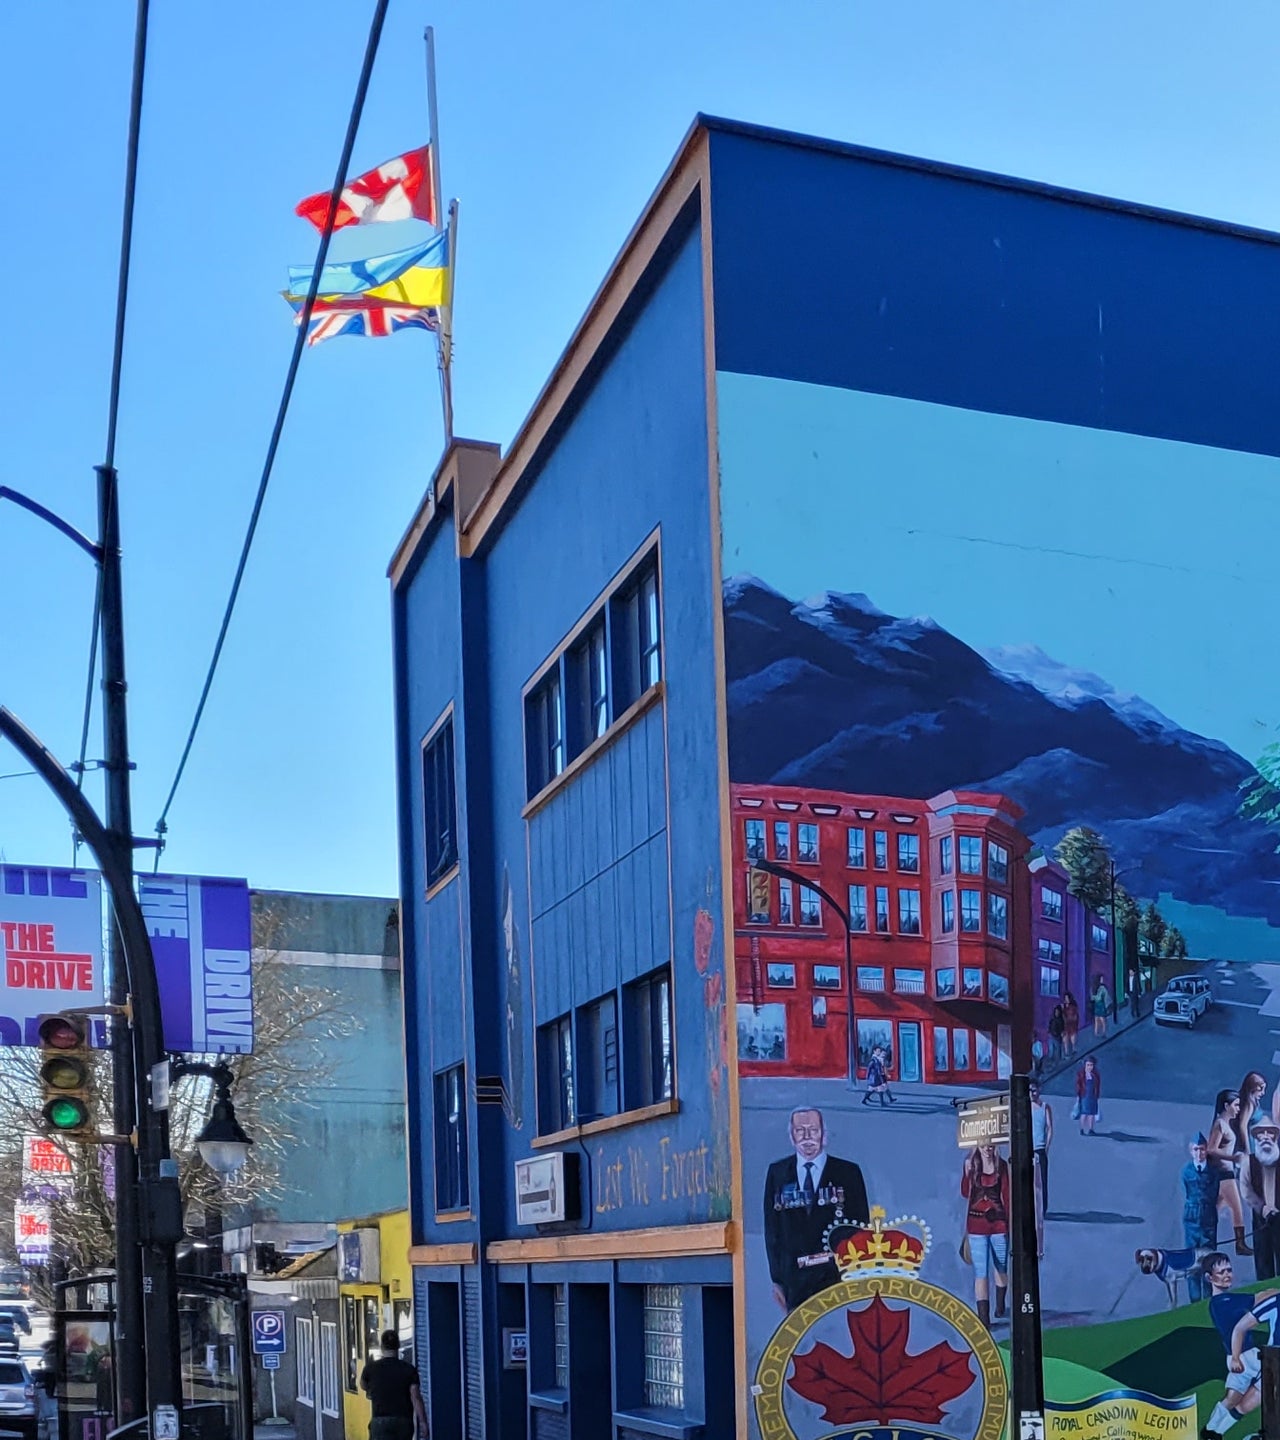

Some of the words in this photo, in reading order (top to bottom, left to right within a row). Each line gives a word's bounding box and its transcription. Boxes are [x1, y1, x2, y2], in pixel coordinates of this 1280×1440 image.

[2, 921, 55, 952] THE
[6, 959, 94, 991] DRIVE
[961, 1114, 1000, 1138] Commercial
[1021, 1303, 1034, 1314] 65
[1024, 1293, 1030, 1303] 8
[1052, 1416, 1083, 1432] ROYAL
[1086, 1406, 1139, 1427] CANADIAN
[1144, 1412, 1188, 1430] LEGION
